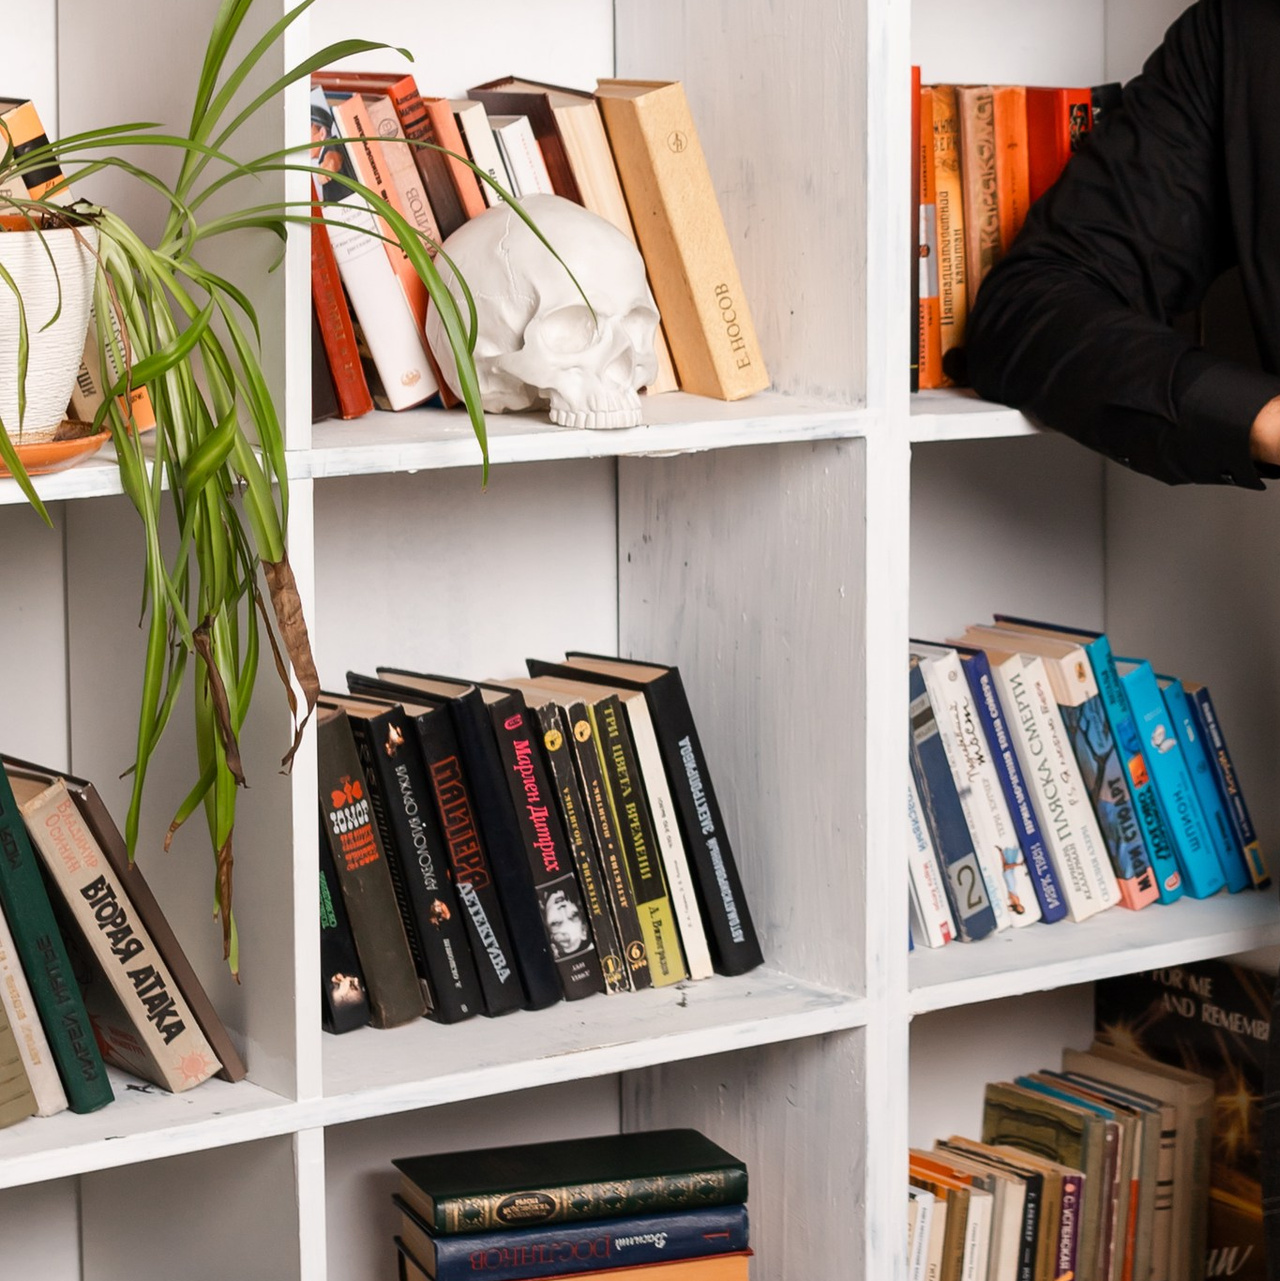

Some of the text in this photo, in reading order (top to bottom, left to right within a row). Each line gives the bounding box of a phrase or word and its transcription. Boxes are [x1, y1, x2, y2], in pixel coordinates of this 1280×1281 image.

[937, 190, 955, 327] Пятнадцатилетний
[952, 227, 964, 286] капитан
[429, 755, 492, 891] МАСТЕРА
[513, 738, 560, 873] Марлен Дитрих
[602, 705, 653, 880] ТРИ ЦВЕТА ВРЕМЕНИ
[980, 673, 1059, 910] МАРК ТВЕН ПРИКЛЮЧЕНИЯ ТОМА СОЙЕРА
[1009, 673, 1073, 844] ПЛЯСКА СМЕРТИ
[396, 764, 439, 892] АРХЕОЛОГИЯ ОРУЖИЯ
[563, 786, 602, 917] ДЕТЕКТИВ ПОЛИТИКА
[590, 779, 630, 909] ДЕТЕКТИВ ПОЛИТИКА
[677, 735, 745, 944] АВТОМАТИЗИРОВАННЫЙ ЭЛЕКТРОПРИВОД
[956, 863, 983, 911] 2
[1108, 777, 1152, 892] МЕРИ СТЮАРТ
[1137, 794, 1165, 863] ЛОГОВО
[80, 874, 187, 1046] ВТОРАЯ АТАКА
[456, 882, 511, 984] ДЕТЕКТИВА
[1161, 993, 1195, 1019] AND
[469, 1233, 668, 1272] Василий РОСЛЯКОВ
[1059, 1206, 1073, 1272] УСПЕНСКАЯ
